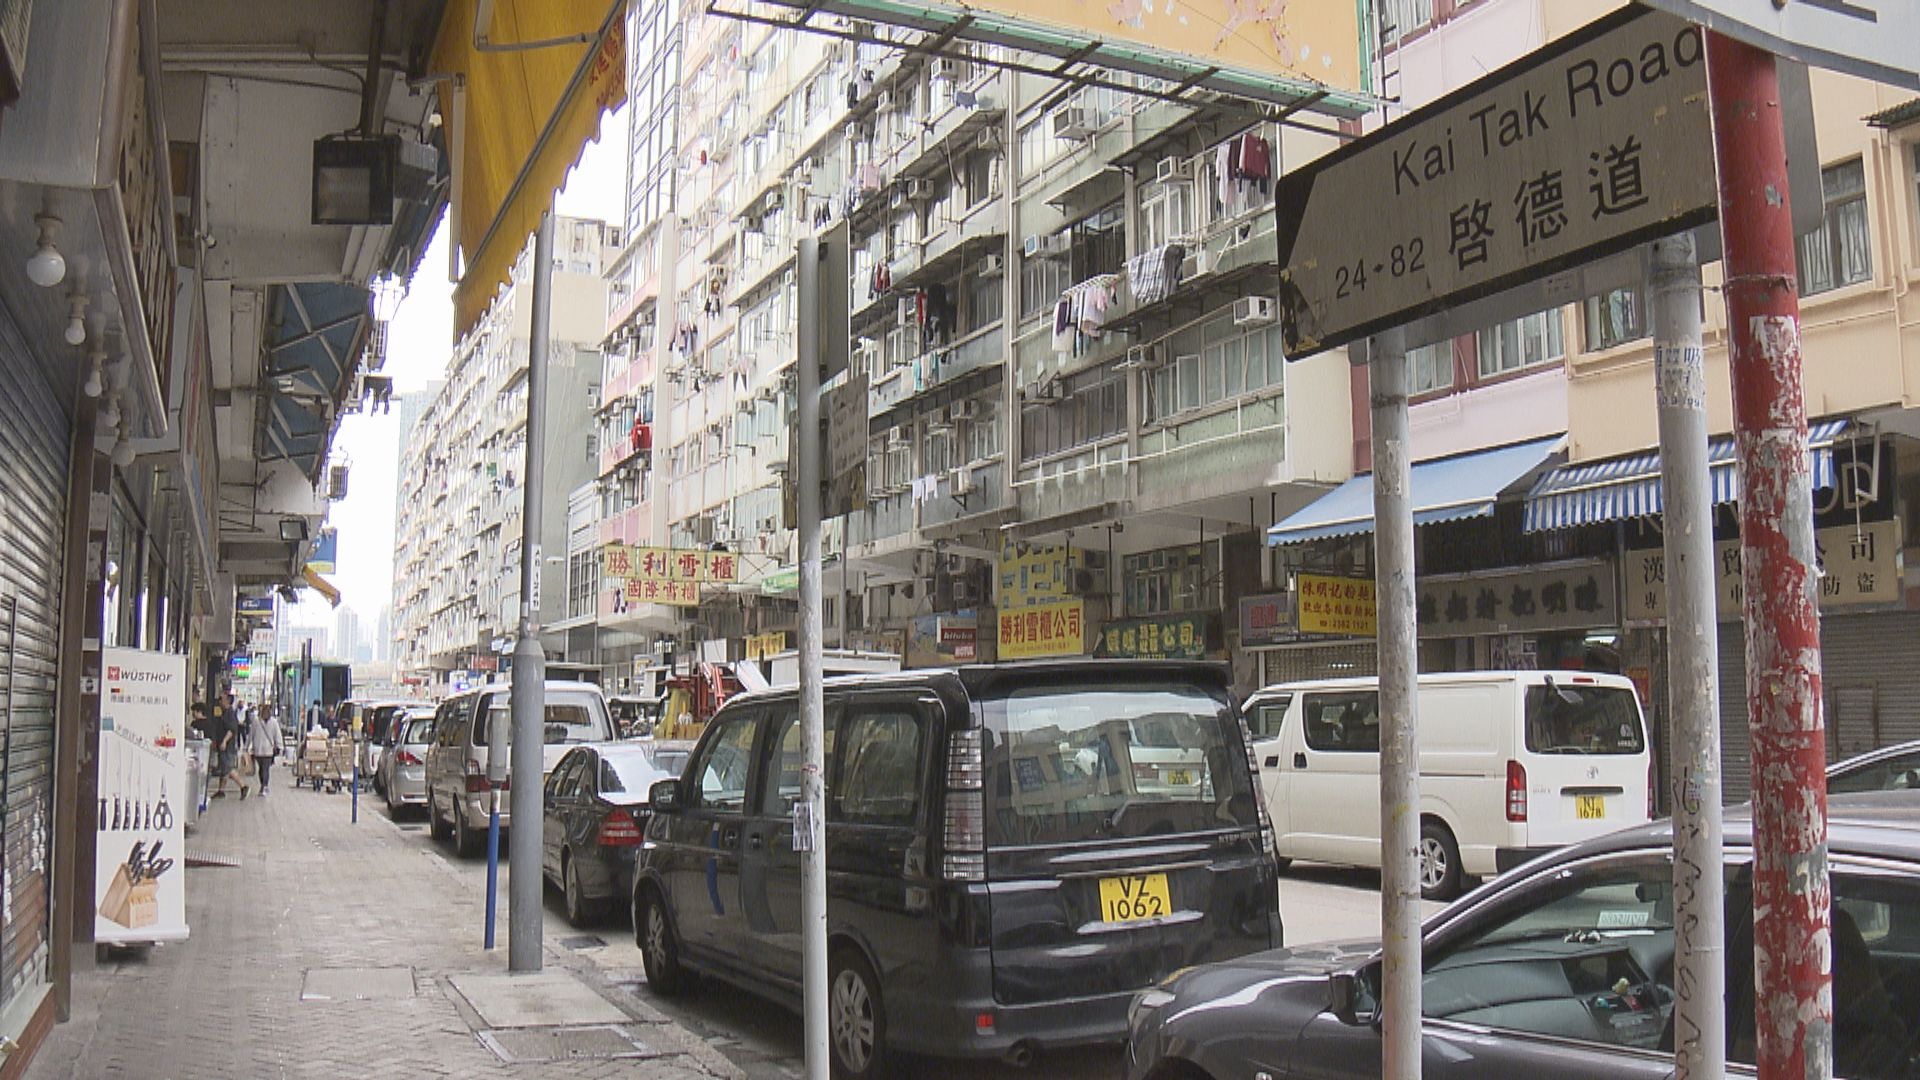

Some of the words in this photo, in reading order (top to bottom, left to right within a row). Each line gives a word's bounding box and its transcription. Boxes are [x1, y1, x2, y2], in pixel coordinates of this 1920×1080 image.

[1393, 128, 1457, 196] Kai
[1468, 90, 1550, 158] Tak
[606, 548, 736, 581] 勝利雪櫃
[1001, 607, 1080, 645] 勝利雪櫃公司
[121, 668, 172, 683] WÜSTHOF
[1117, 876, 1150, 898] VZ
[1109, 895, 1164, 921] 1062
